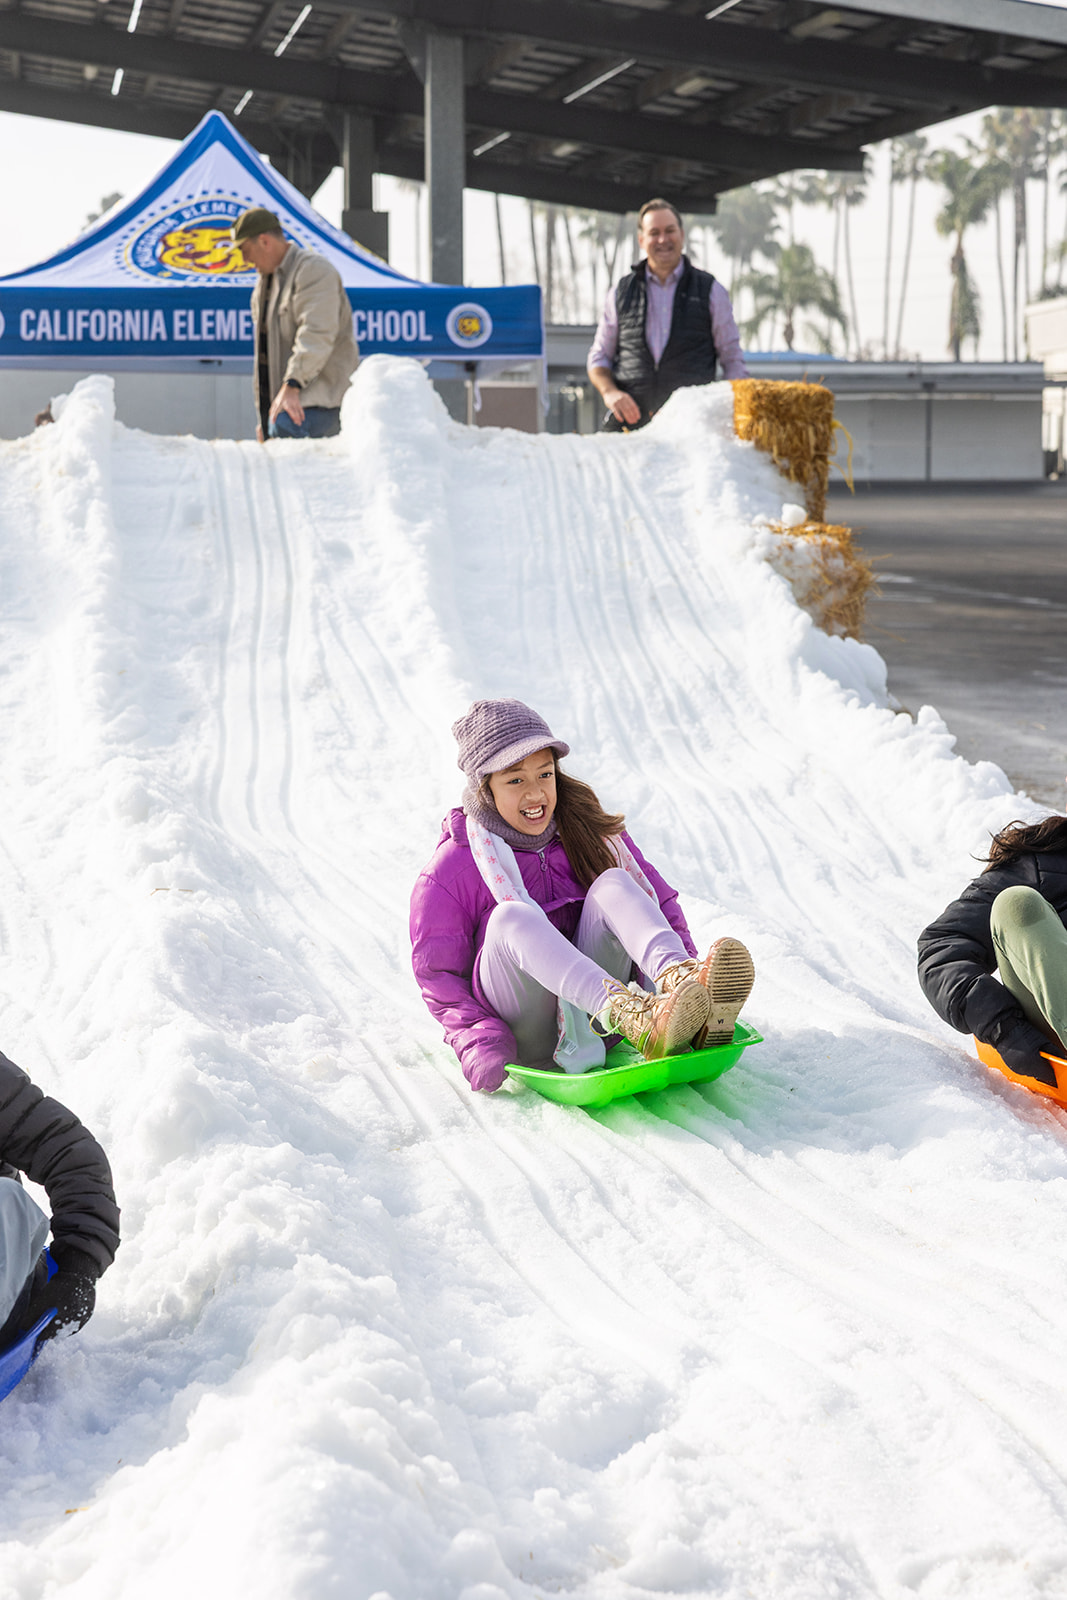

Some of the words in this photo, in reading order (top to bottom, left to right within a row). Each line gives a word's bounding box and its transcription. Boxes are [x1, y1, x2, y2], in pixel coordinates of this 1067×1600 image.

[20, 309, 167, 341] CALIFORNIA
[173, 309, 254, 341] ELEME
[352, 309, 433, 342] CHOOL
